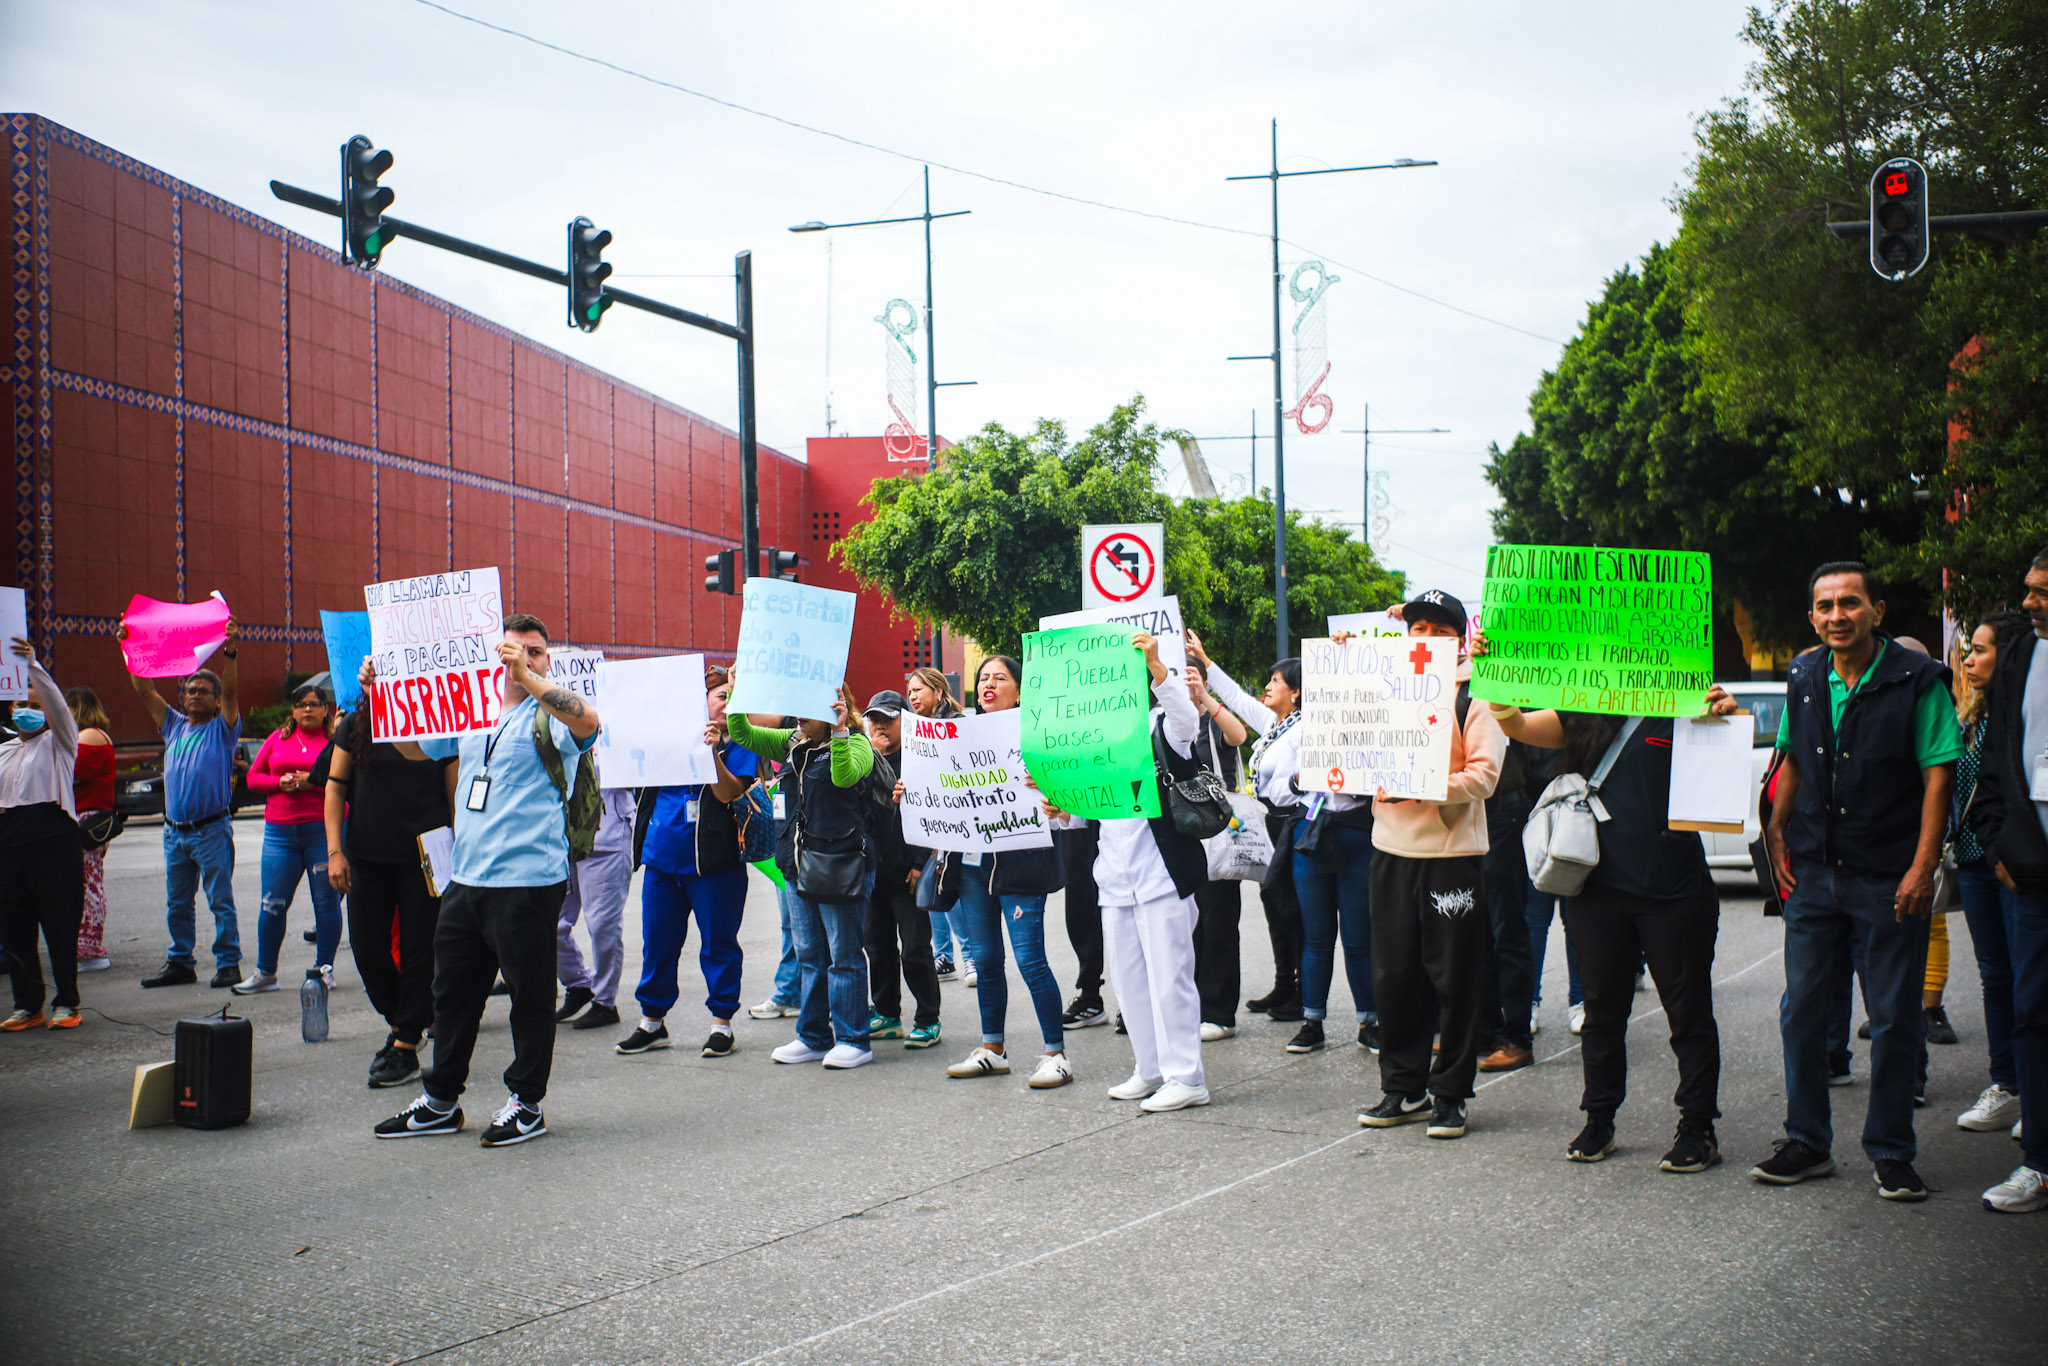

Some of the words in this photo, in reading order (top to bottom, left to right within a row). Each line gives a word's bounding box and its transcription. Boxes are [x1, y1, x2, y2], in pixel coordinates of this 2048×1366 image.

[1594, 550, 1707, 588] ESENCIALES,
[389, 571, 470, 603] LLAMAN
[765, 588, 853, 625] estatal
[1485, 582, 1520, 603] PERO
[1527, 584, 1582, 605] PAGAN
[1589, 585, 1710, 619] MISERABLES!
[1629, 611, 1699, 631] ABUSO
[784, 631, 801, 648] a
[1077, 633, 1129, 653] amor
[1628, 624, 1709, 650] LABORAL!
[371, 651, 398, 676] NOS
[405, 634, 488, 675] PAGAN
[1305, 640, 1378, 675] SERVICIOS
[1380, 655, 1395, 675] DE
[1576, 643, 1593, 662] EL
[1602, 644, 1673, 667] TRABAJO.
[1029, 675, 1042, 690] a
[1065, 659, 1128, 688] PUEBLA
[1476, 661, 1562, 687] VALORAMOS
[1566, 667, 1578, 687] A
[1583, 670, 1609, 690] LOS
[1618, 669, 1713, 691] TRABAJADORES
[1343, 690, 1350, 703] A
[1380, 673, 1442, 703] SALUD
[370, 666, 505, 739] MISERABLES
[1048, 689, 1138, 719] TEHUACÁN
[1598, 689, 1677, 713] ARMENTA
[915, 719, 959, 740] AMOR
[1318, 710, 1336, 724] POR
[911, 739, 940, 759] PUEBLA
[1044, 727, 1104, 749] bases
[1317, 734, 1326, 747] DE
[1331, 729, 1374, 747] CONTRATO
[1380, 729, 1430, 748] QUEREMOS
[950, 755, 962, 771] &
[969, 749, 997, 768] POR
[1041, 759, 1079, 779] para
[1093, 747, 1116, 766] el
[1301, 751, 1342, 769] IGUALDAD
[904, 787, 921, 807] los
[925, 787, 940, 809] de
[943, 787, 1017, 809] contrato
[920, 817, 971, 839] queremos
[974, 807, 1044, 844] igualdad
